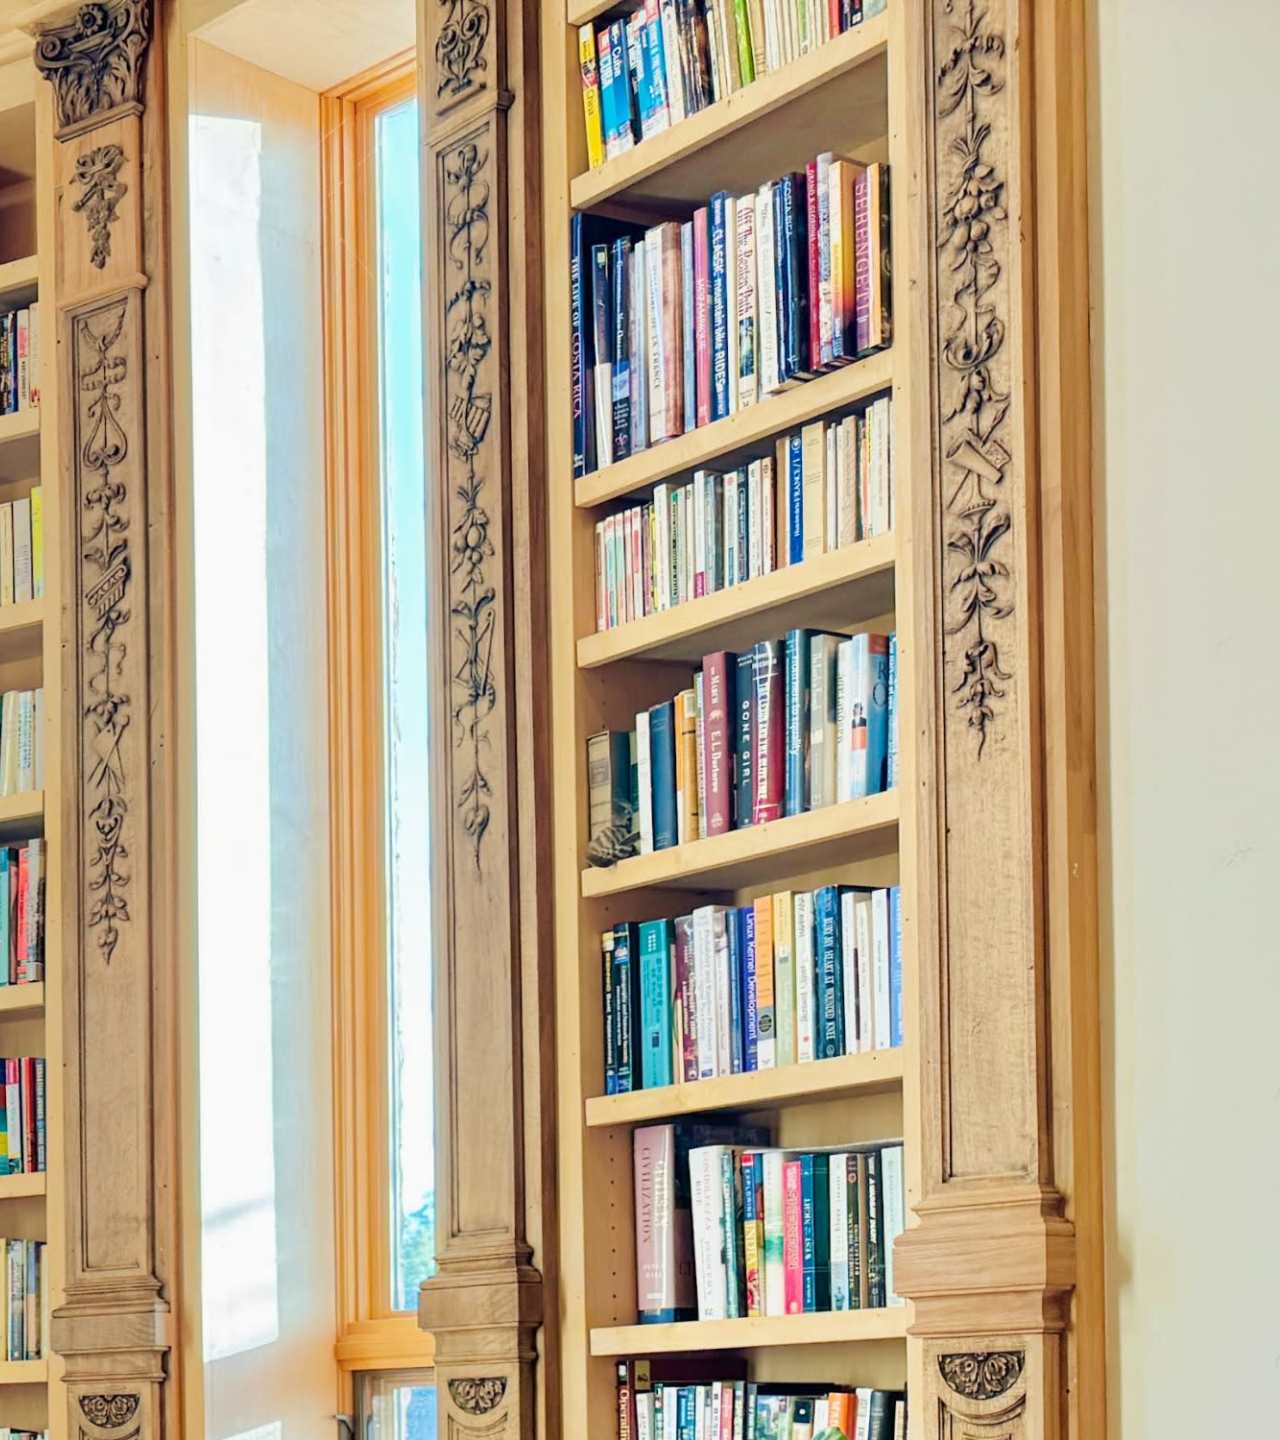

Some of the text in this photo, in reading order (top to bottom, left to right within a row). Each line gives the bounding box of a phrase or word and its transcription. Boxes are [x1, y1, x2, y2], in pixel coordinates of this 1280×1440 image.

[612, 46, 622, 78] Cuba
[572, 257, 580, 282] THE
[854, 184, 868, 314] SERENGETI
[712, 229, 726, 385] CLASSIC mountain bike RIDES
[572, 333, 582, 381] COSTA
[573, 386, 582, 420] RICA
[710, 675, 720, 704] MARCH
[742, 700, 750, 786] GONE GIRL
[746, 913, 756, 1039] Linux Kernel Development
[642, 1147, 651, 1244] CIVILIZATION
[804, 1198, 812, 1224] NIGHT
[745, 1222, 758, 1267] INDIA
